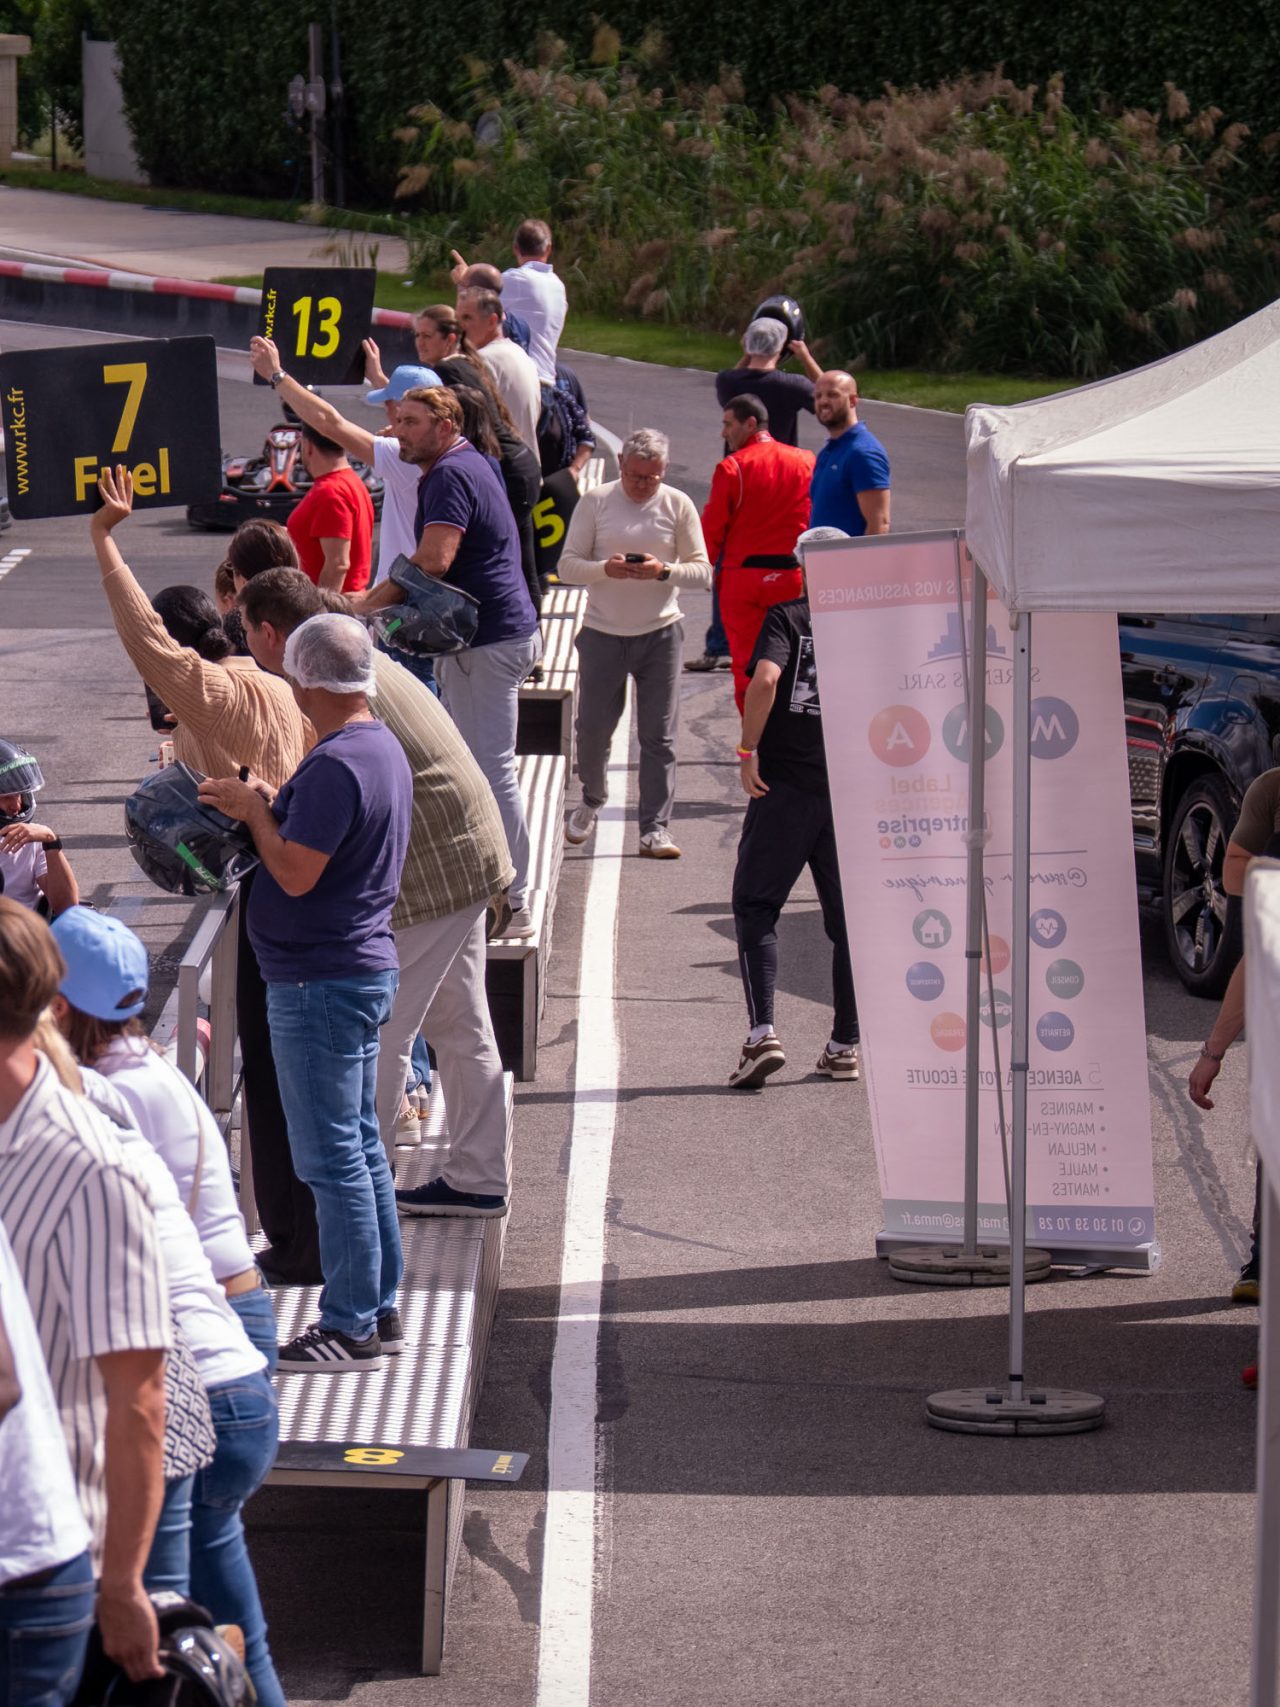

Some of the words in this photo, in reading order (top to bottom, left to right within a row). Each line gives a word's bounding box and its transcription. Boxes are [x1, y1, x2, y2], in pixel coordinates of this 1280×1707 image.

[264, 288, 277, 339] w.rkc.fr
[293, 296, 342, 358] 13
[103, 362, 148, 453] 7
[7, 387, 29, 495] www.rkc.fr
[274, 431, 297, 443] 14
[531, 496, 565, 548] 5
[343, 1447, 405, 1465] 8
